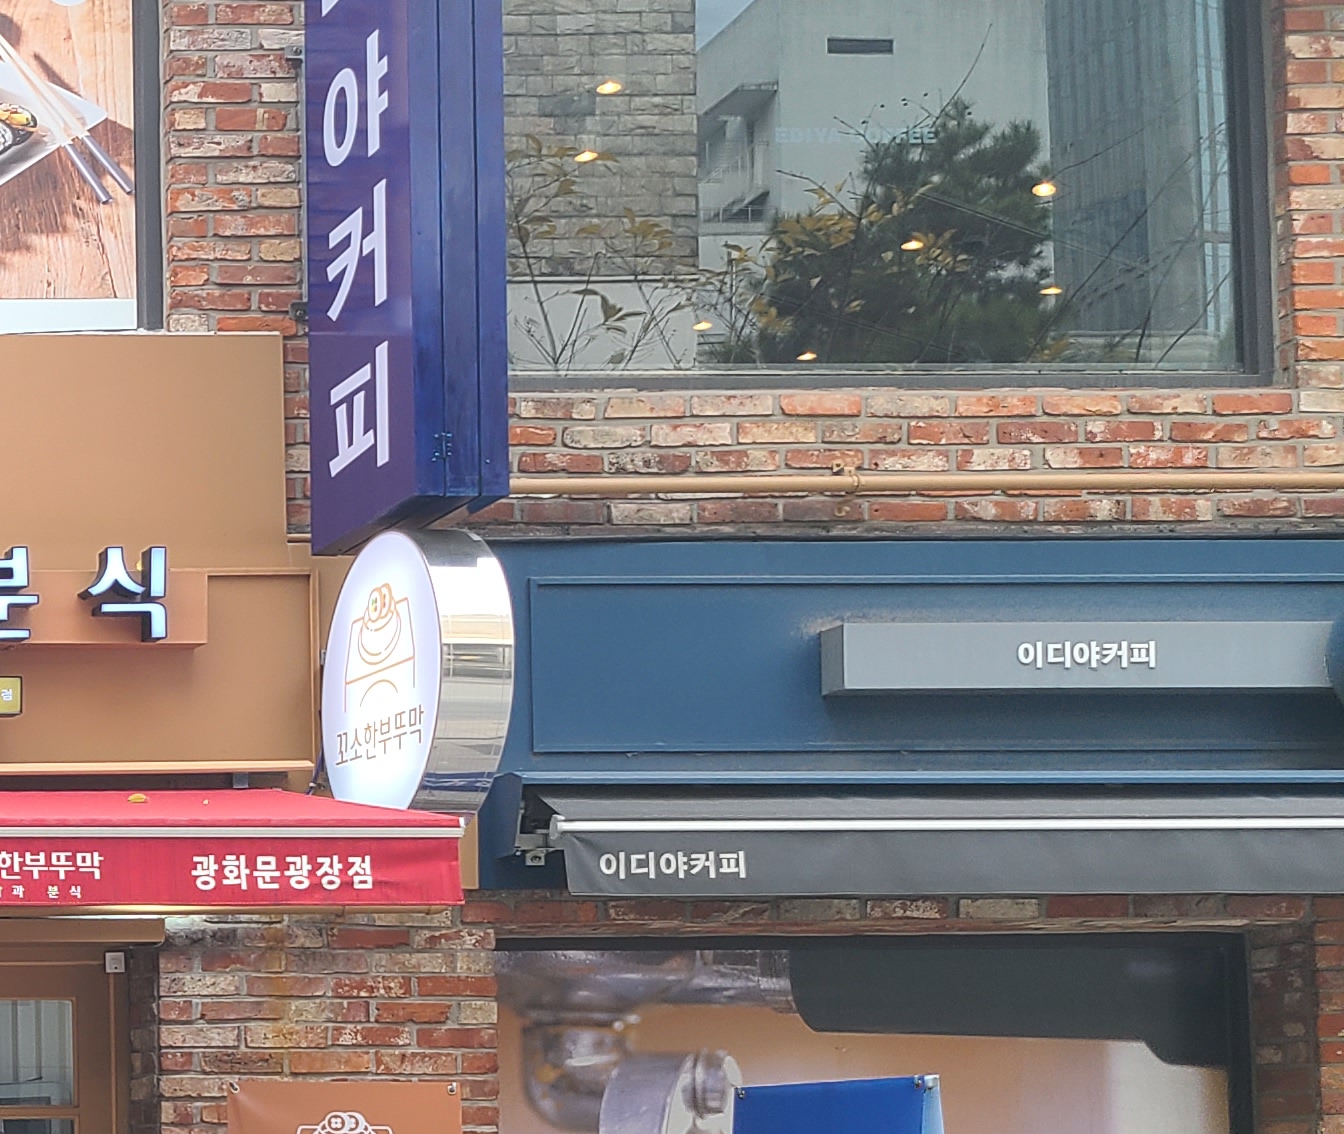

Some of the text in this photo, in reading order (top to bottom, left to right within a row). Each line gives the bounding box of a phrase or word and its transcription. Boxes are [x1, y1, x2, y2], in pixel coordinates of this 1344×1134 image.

[322, 0, 389, 477] 야커피
[1017, 639, 1158, 669] 이디야커피
[335, 704, 424, 766] 꼬소한부뚜막
[190, 853, 374, 891] 광화문광장점
[598, 850, 747, 881] 이디야커피
[48, 884, 82, 899] 분식
